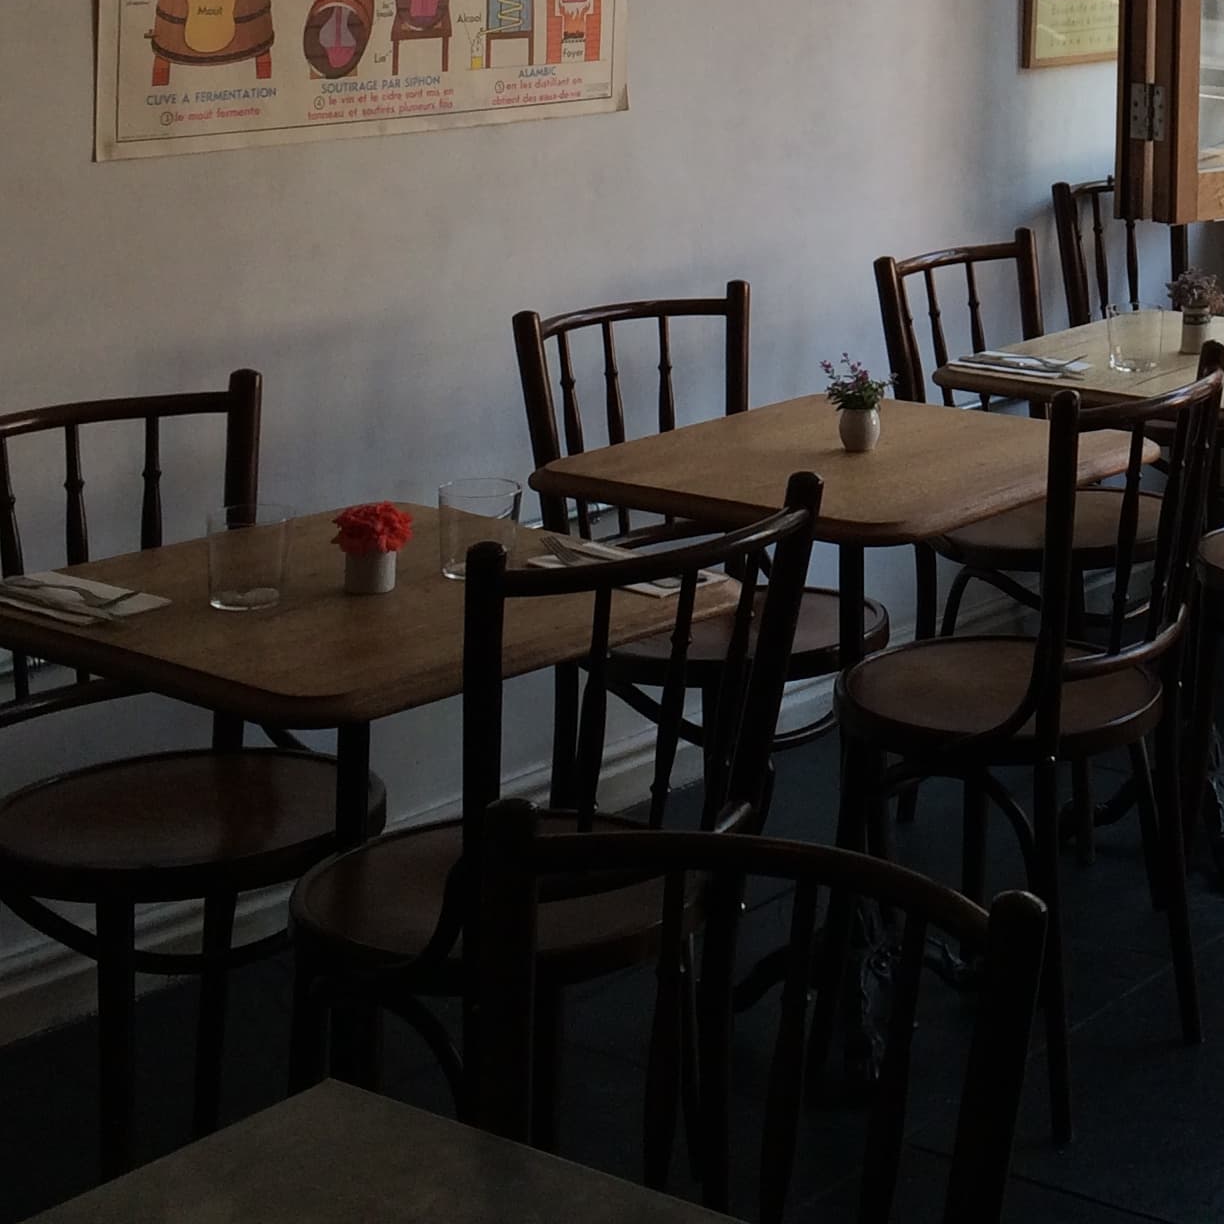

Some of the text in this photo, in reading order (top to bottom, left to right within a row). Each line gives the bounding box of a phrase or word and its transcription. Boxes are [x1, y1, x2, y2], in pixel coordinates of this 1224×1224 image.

[457, 12, 481, 23] Alcool
[518, 66, 557, 79] ALAMBIC
[321, 75, 440, 94] SOUTIRAGE PAR SIPHON
[146, 88, 277, 106] CUVE A FERMENTATION
[381, 90, 402, 101] cidre
[523, 92, 537, 103] des
[307, 110, 344, 121] tonneau
